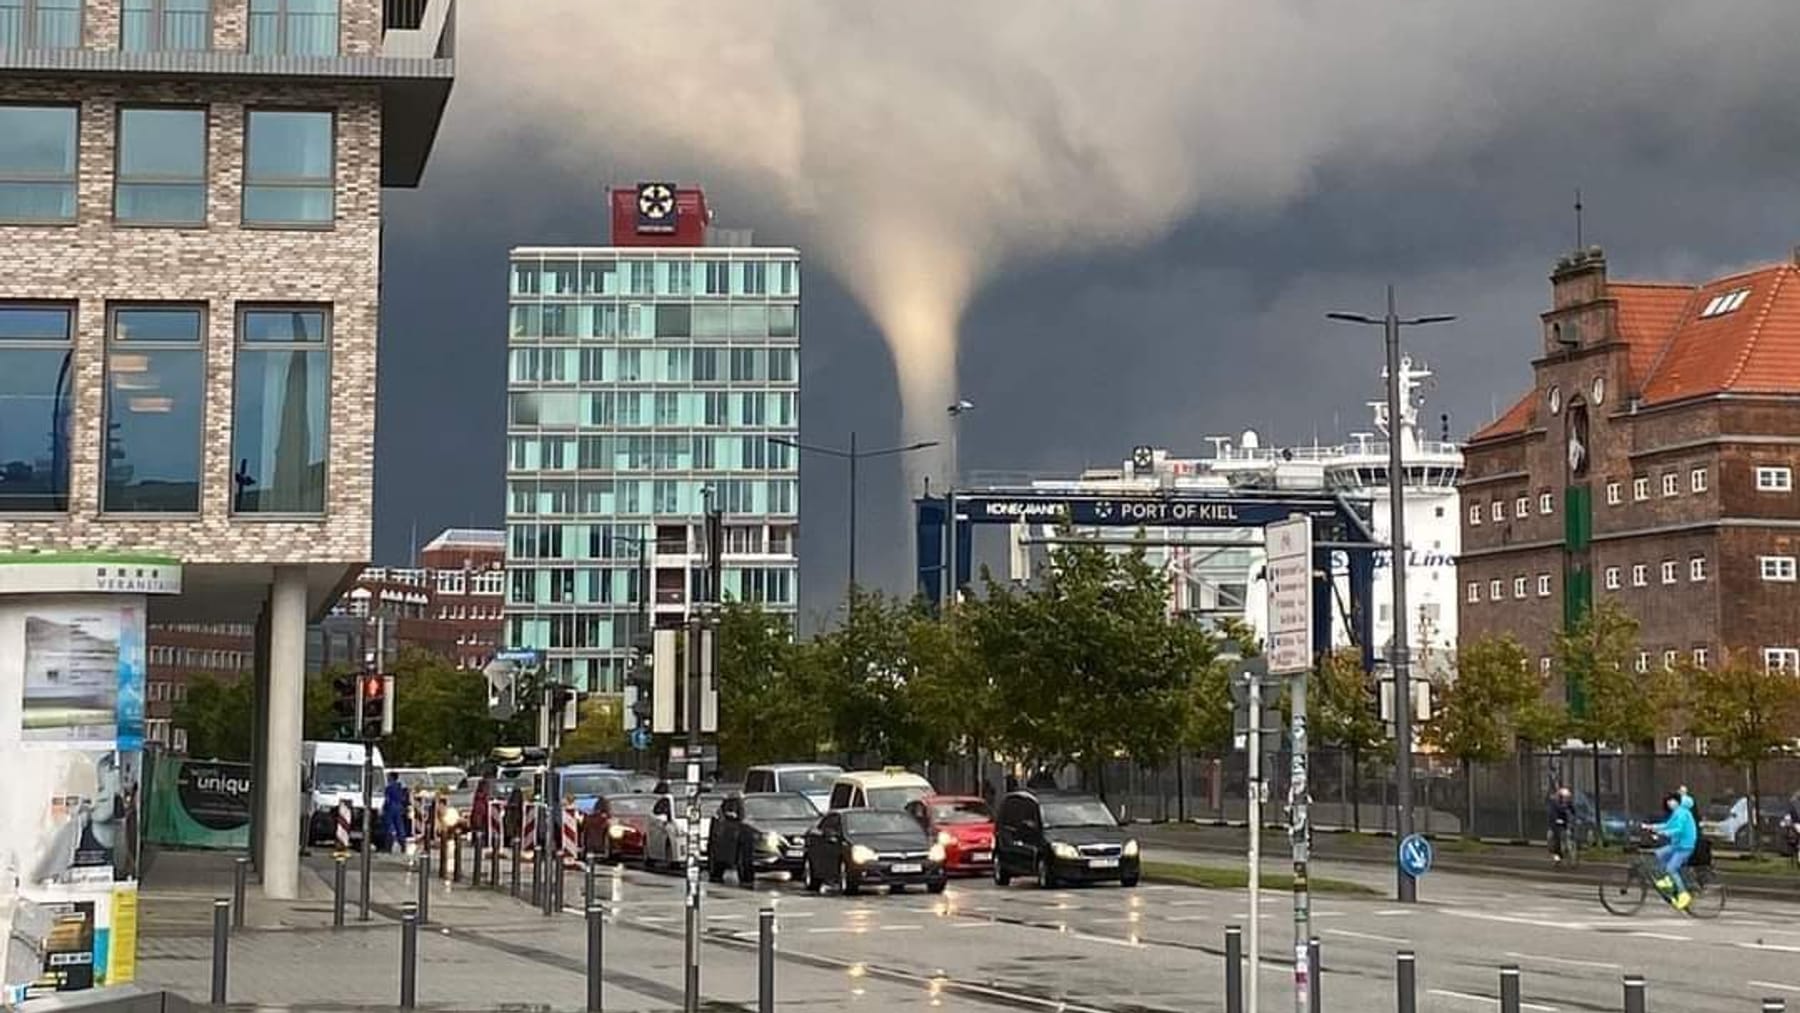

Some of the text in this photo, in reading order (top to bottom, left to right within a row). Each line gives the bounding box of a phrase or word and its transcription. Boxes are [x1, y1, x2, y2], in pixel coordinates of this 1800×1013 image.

[1121, 503, 1238, 519] PORT OF KIEL
